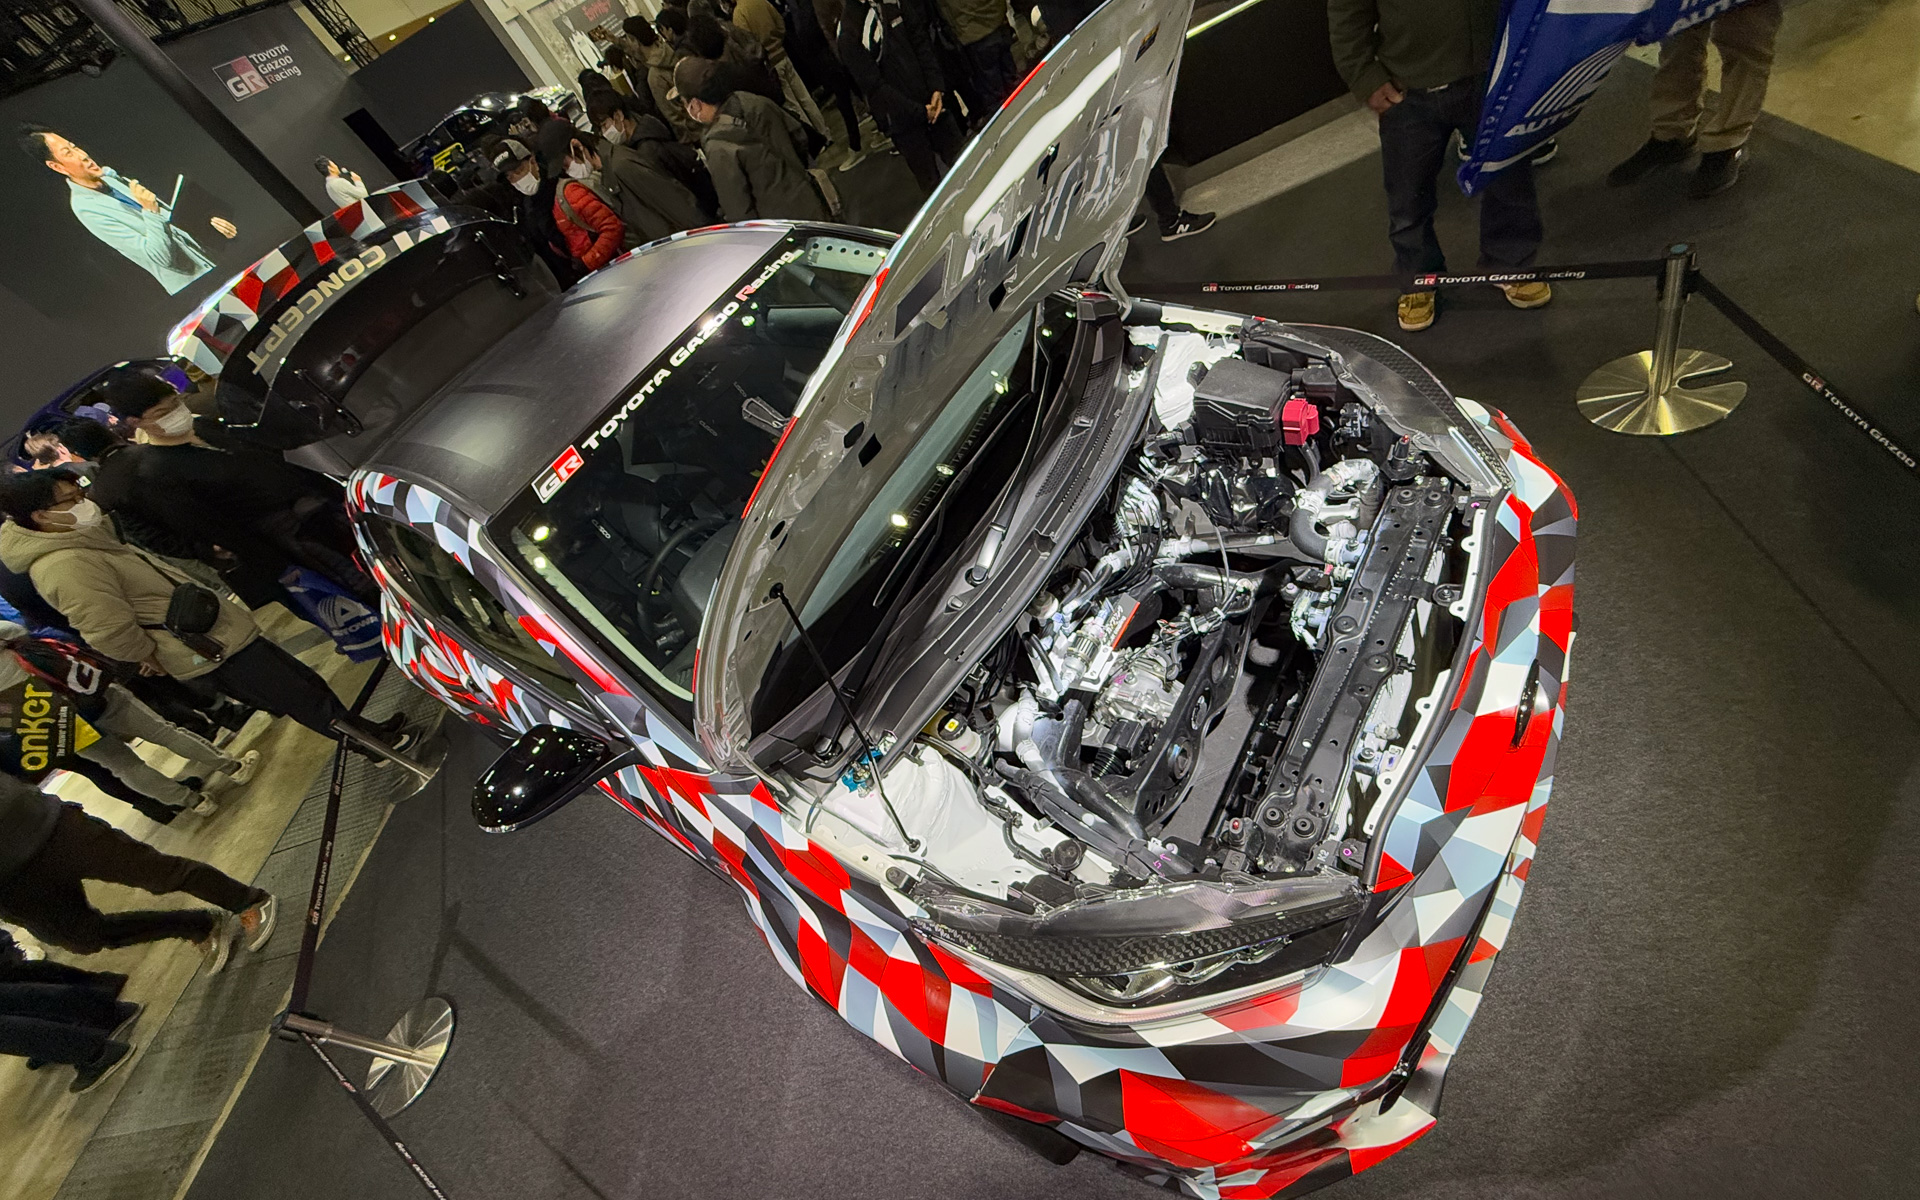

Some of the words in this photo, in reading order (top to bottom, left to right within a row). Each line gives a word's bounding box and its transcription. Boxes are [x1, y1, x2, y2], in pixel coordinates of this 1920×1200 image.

[248, 44, 290, 64] TOYOTA
[257, 55, 294, 75] GAZOO
[264, 65, 302, 85] Racing
[226, 70, 266, 98] GR
[1176, 224, 1190, 234] N
[1202, 284, 1218, 292] GR
[1414, 277, 1436, 286] GR
[1438, 276, 1486, 284] TOYOTA
[1488, 273, 1536, 282] GAZOO
[247, 245, 387, 376] CONCEPT
[537, 452, 582, 500] GR
[581, 368, 672, 451] TOYOTA
[669, 301, 740, 368] GAZOO
[735, 250, 794, 302] Racing
[1802, 373, 1822, 391] GR
[1824, 388, 1869, 430] TOYOTA
[1870, 428, 1916, 468] GAZOO
[16, 683, 56, 770] anker
